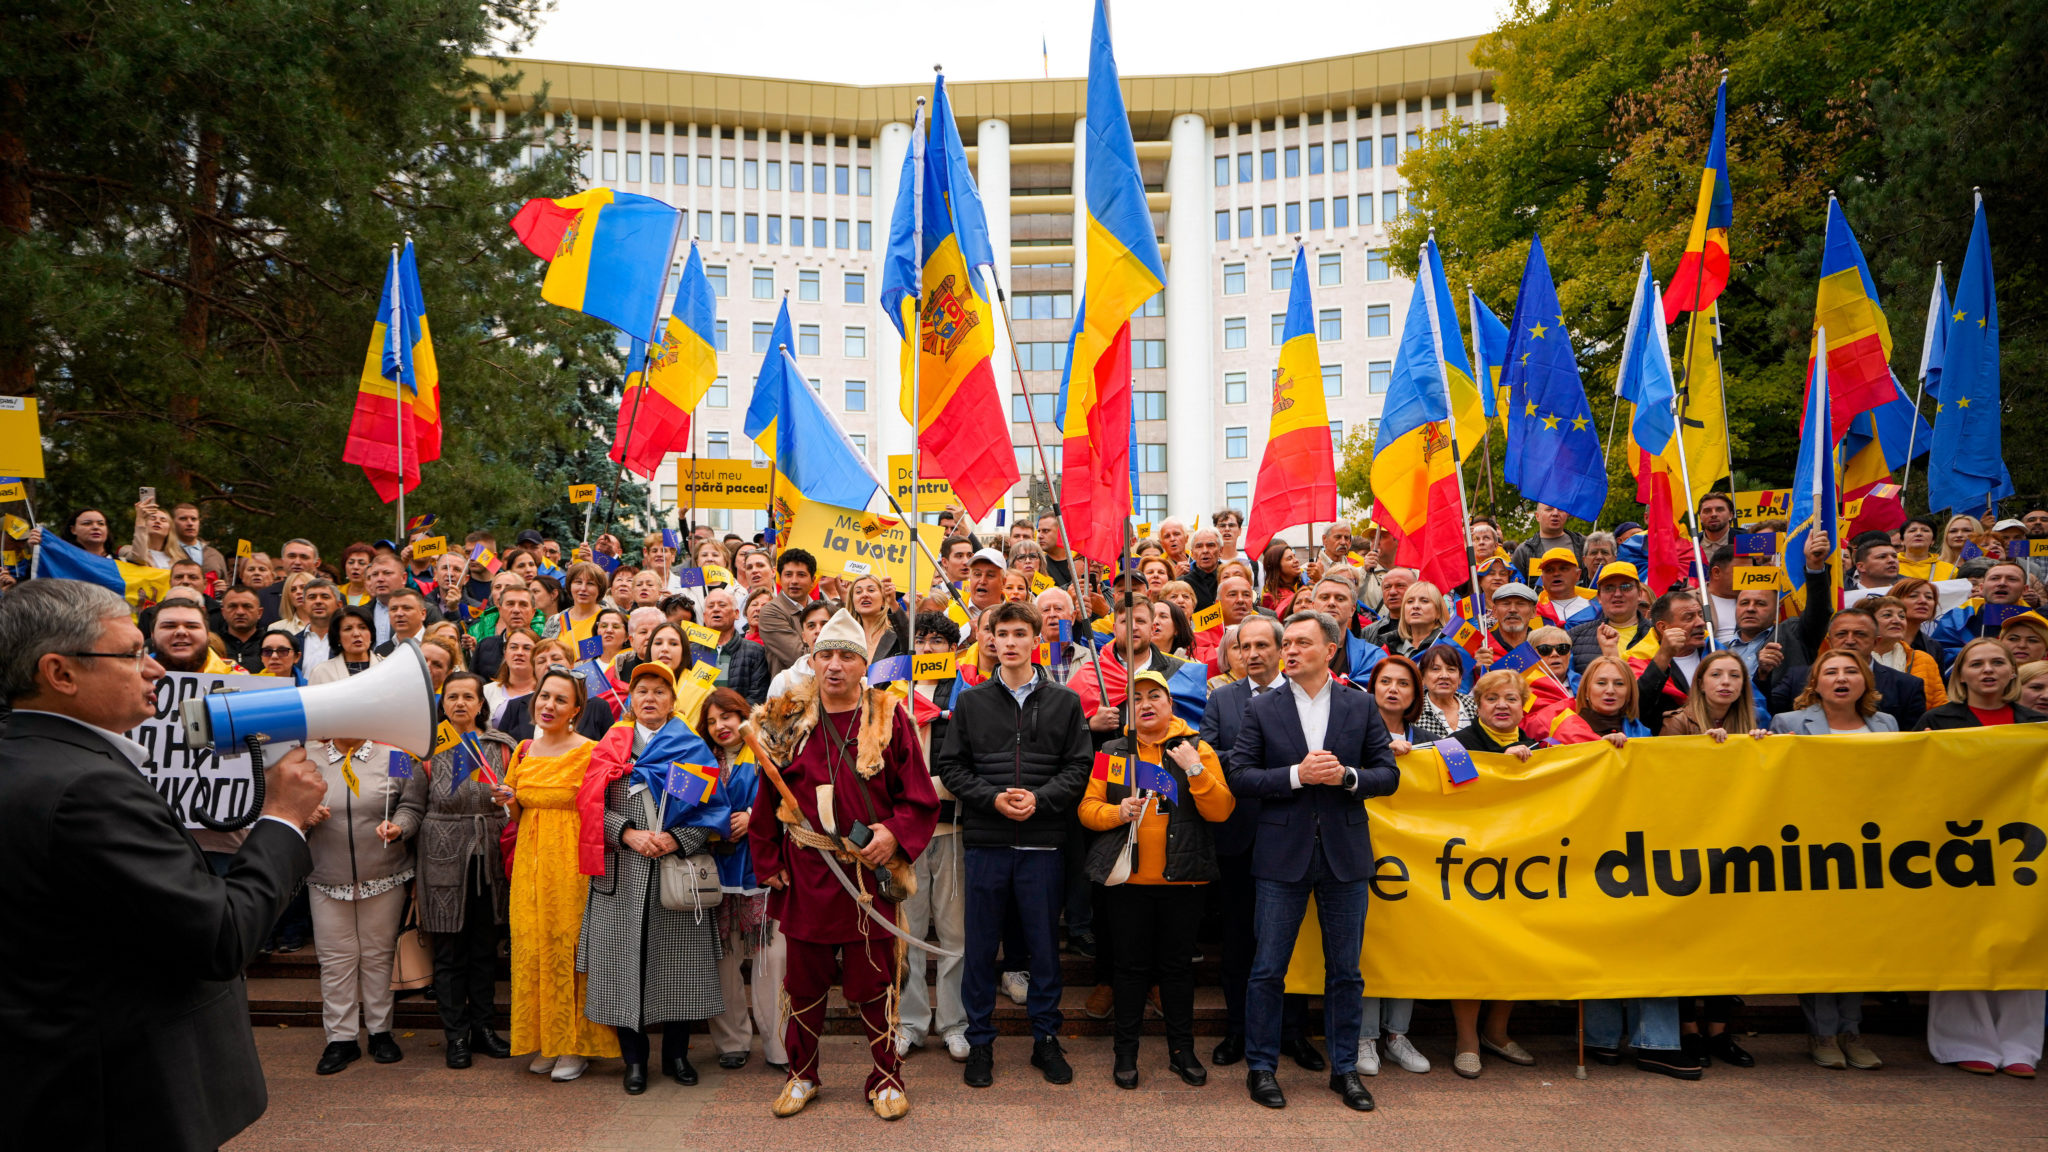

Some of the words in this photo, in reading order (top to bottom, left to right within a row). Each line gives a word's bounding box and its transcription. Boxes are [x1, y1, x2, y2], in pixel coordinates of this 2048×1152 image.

[718, 472, 742, 480] meu
[726, 484, 768, 495] pacea!
[835, 515, 905, 541] Meem
[418, 541, 440, 554] /pas/
[823, 528, 849, 552] la
[856, 539, 907, 564] vot!
[1741, 572, 1778, 584] /pas/
[1200, 607, 1221, 627] /pas/
[685, 625, 714, 641] /pas/
[914, 658, 948, 674] /pas/
[1368, 855, 1410, 901] e
[1435, 837, 1570, 901] faci
[1594, 819, 2048, 899] duminică?
